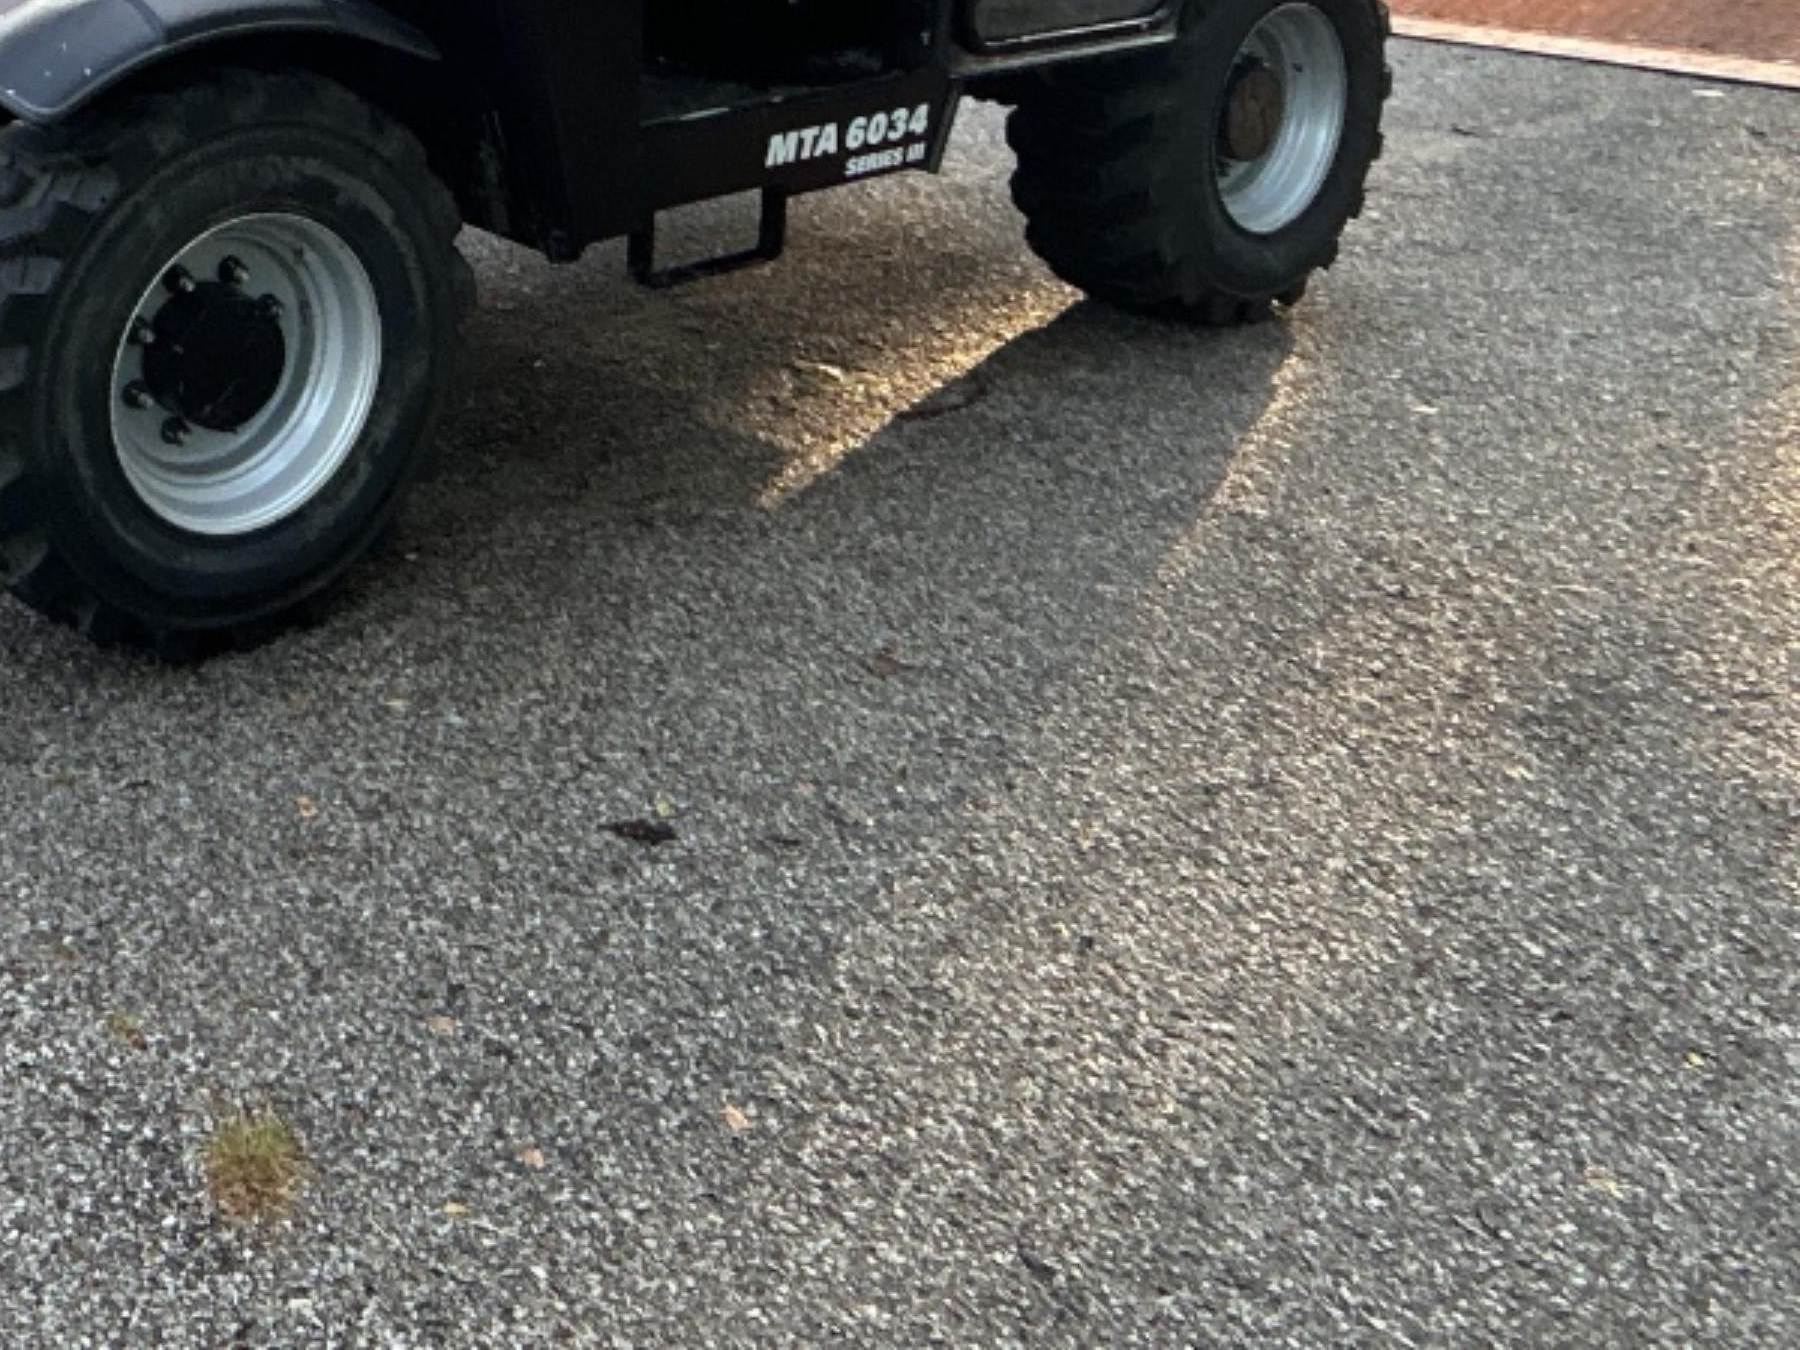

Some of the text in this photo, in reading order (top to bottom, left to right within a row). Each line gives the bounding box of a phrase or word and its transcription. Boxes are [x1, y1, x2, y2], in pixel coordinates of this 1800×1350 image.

[765, 103, 929, 168] MTA 6034
[844, 146, 904, 177] SERIES
